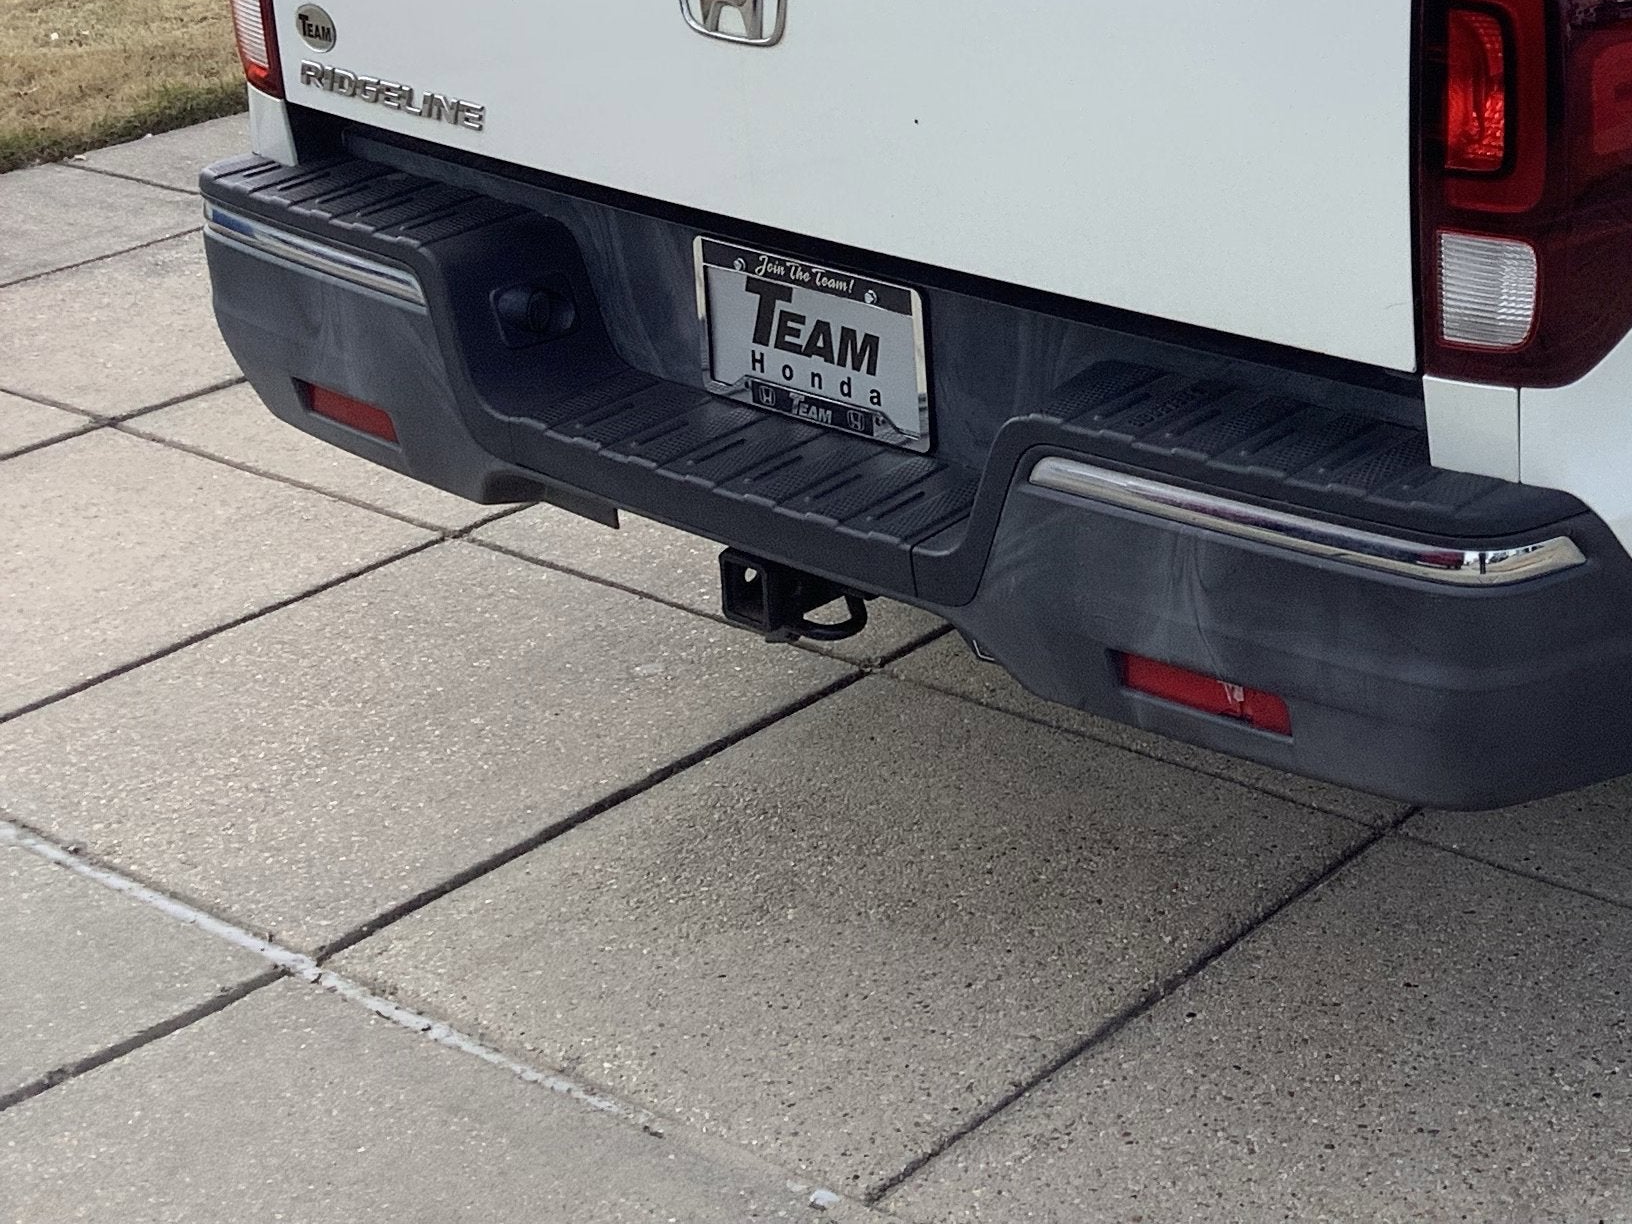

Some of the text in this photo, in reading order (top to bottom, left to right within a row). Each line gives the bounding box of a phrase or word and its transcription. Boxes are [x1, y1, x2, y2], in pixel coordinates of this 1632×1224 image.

[298, 13, 333, 43] TEAM
[300, 59, 486, 132] RIDGELINE
[754, 254, 856, 294] Join The Team!
[745, 276, 880, 376] TEAM
[751, 350, 882, 407] Honda
[788, 393, 833, 424] TEAM
